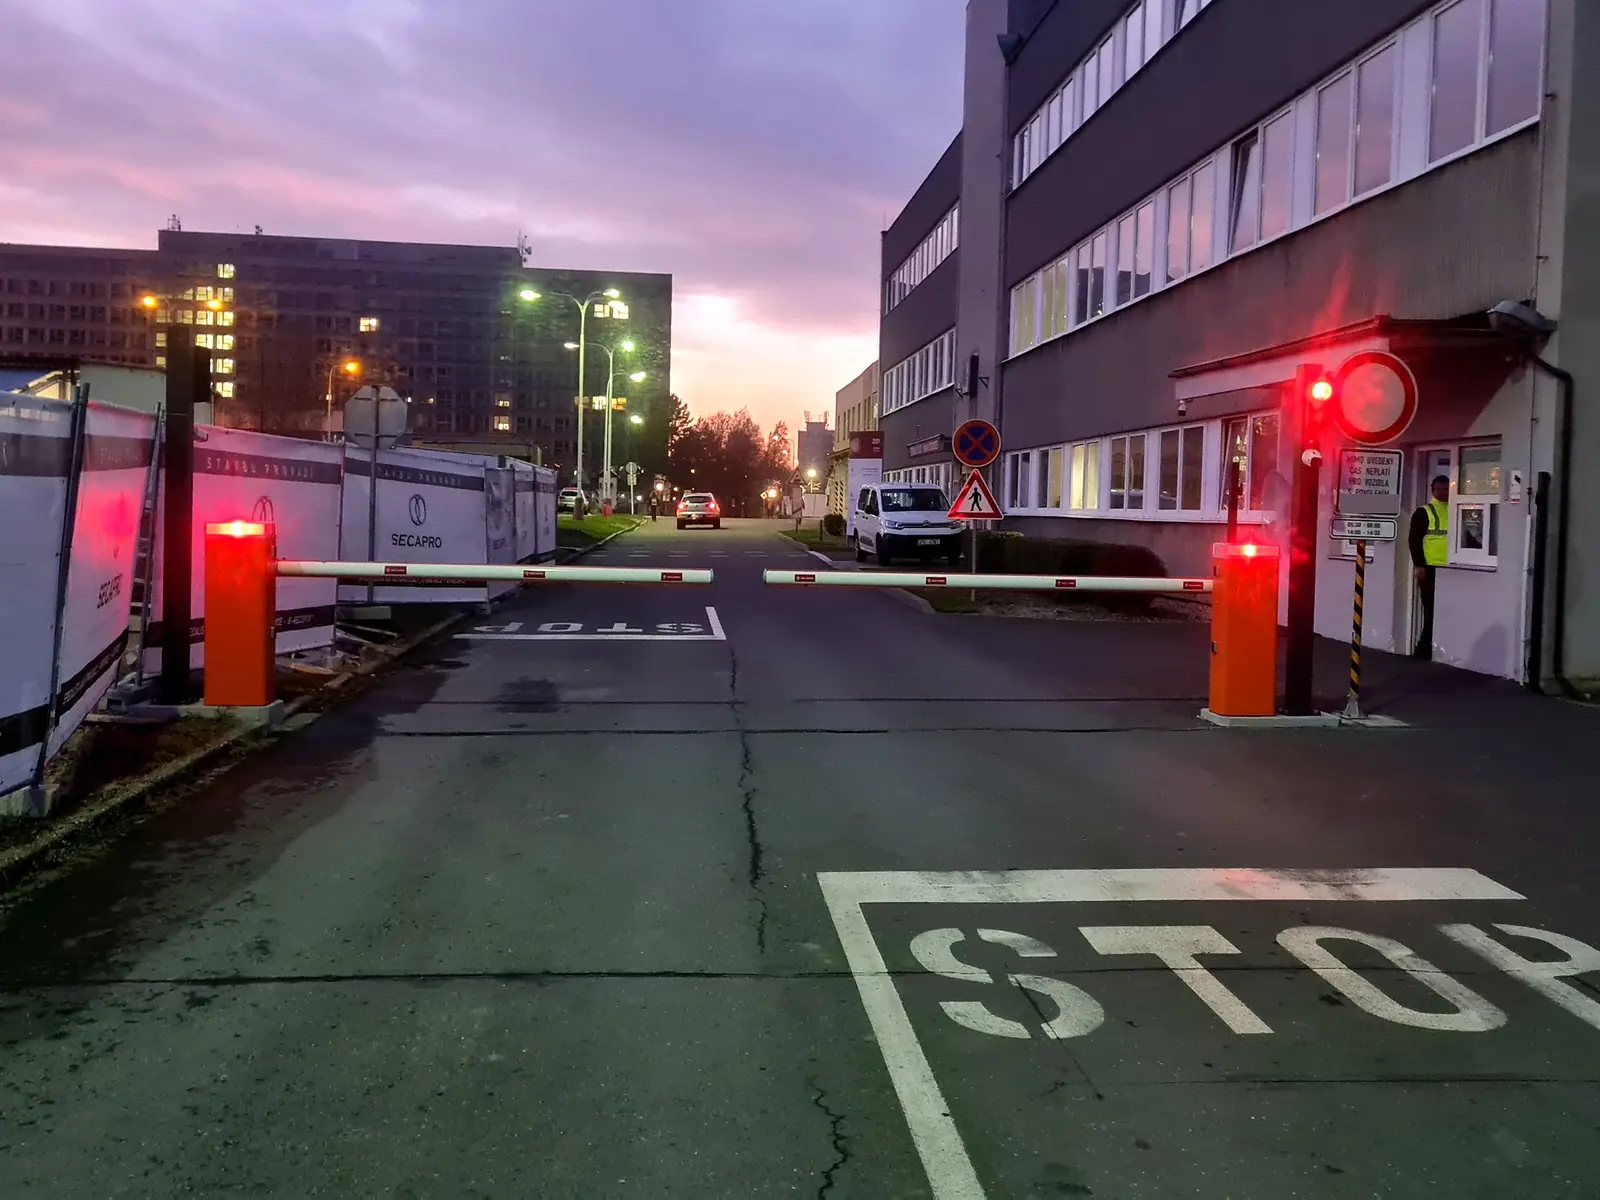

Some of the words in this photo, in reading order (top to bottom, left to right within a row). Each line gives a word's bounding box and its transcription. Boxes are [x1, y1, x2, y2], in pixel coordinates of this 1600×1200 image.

[391, 533, 442, 549] SECAPRO
[473, 622, 704, 633] STOP
[908, 922, 1600, 1039] STOP
